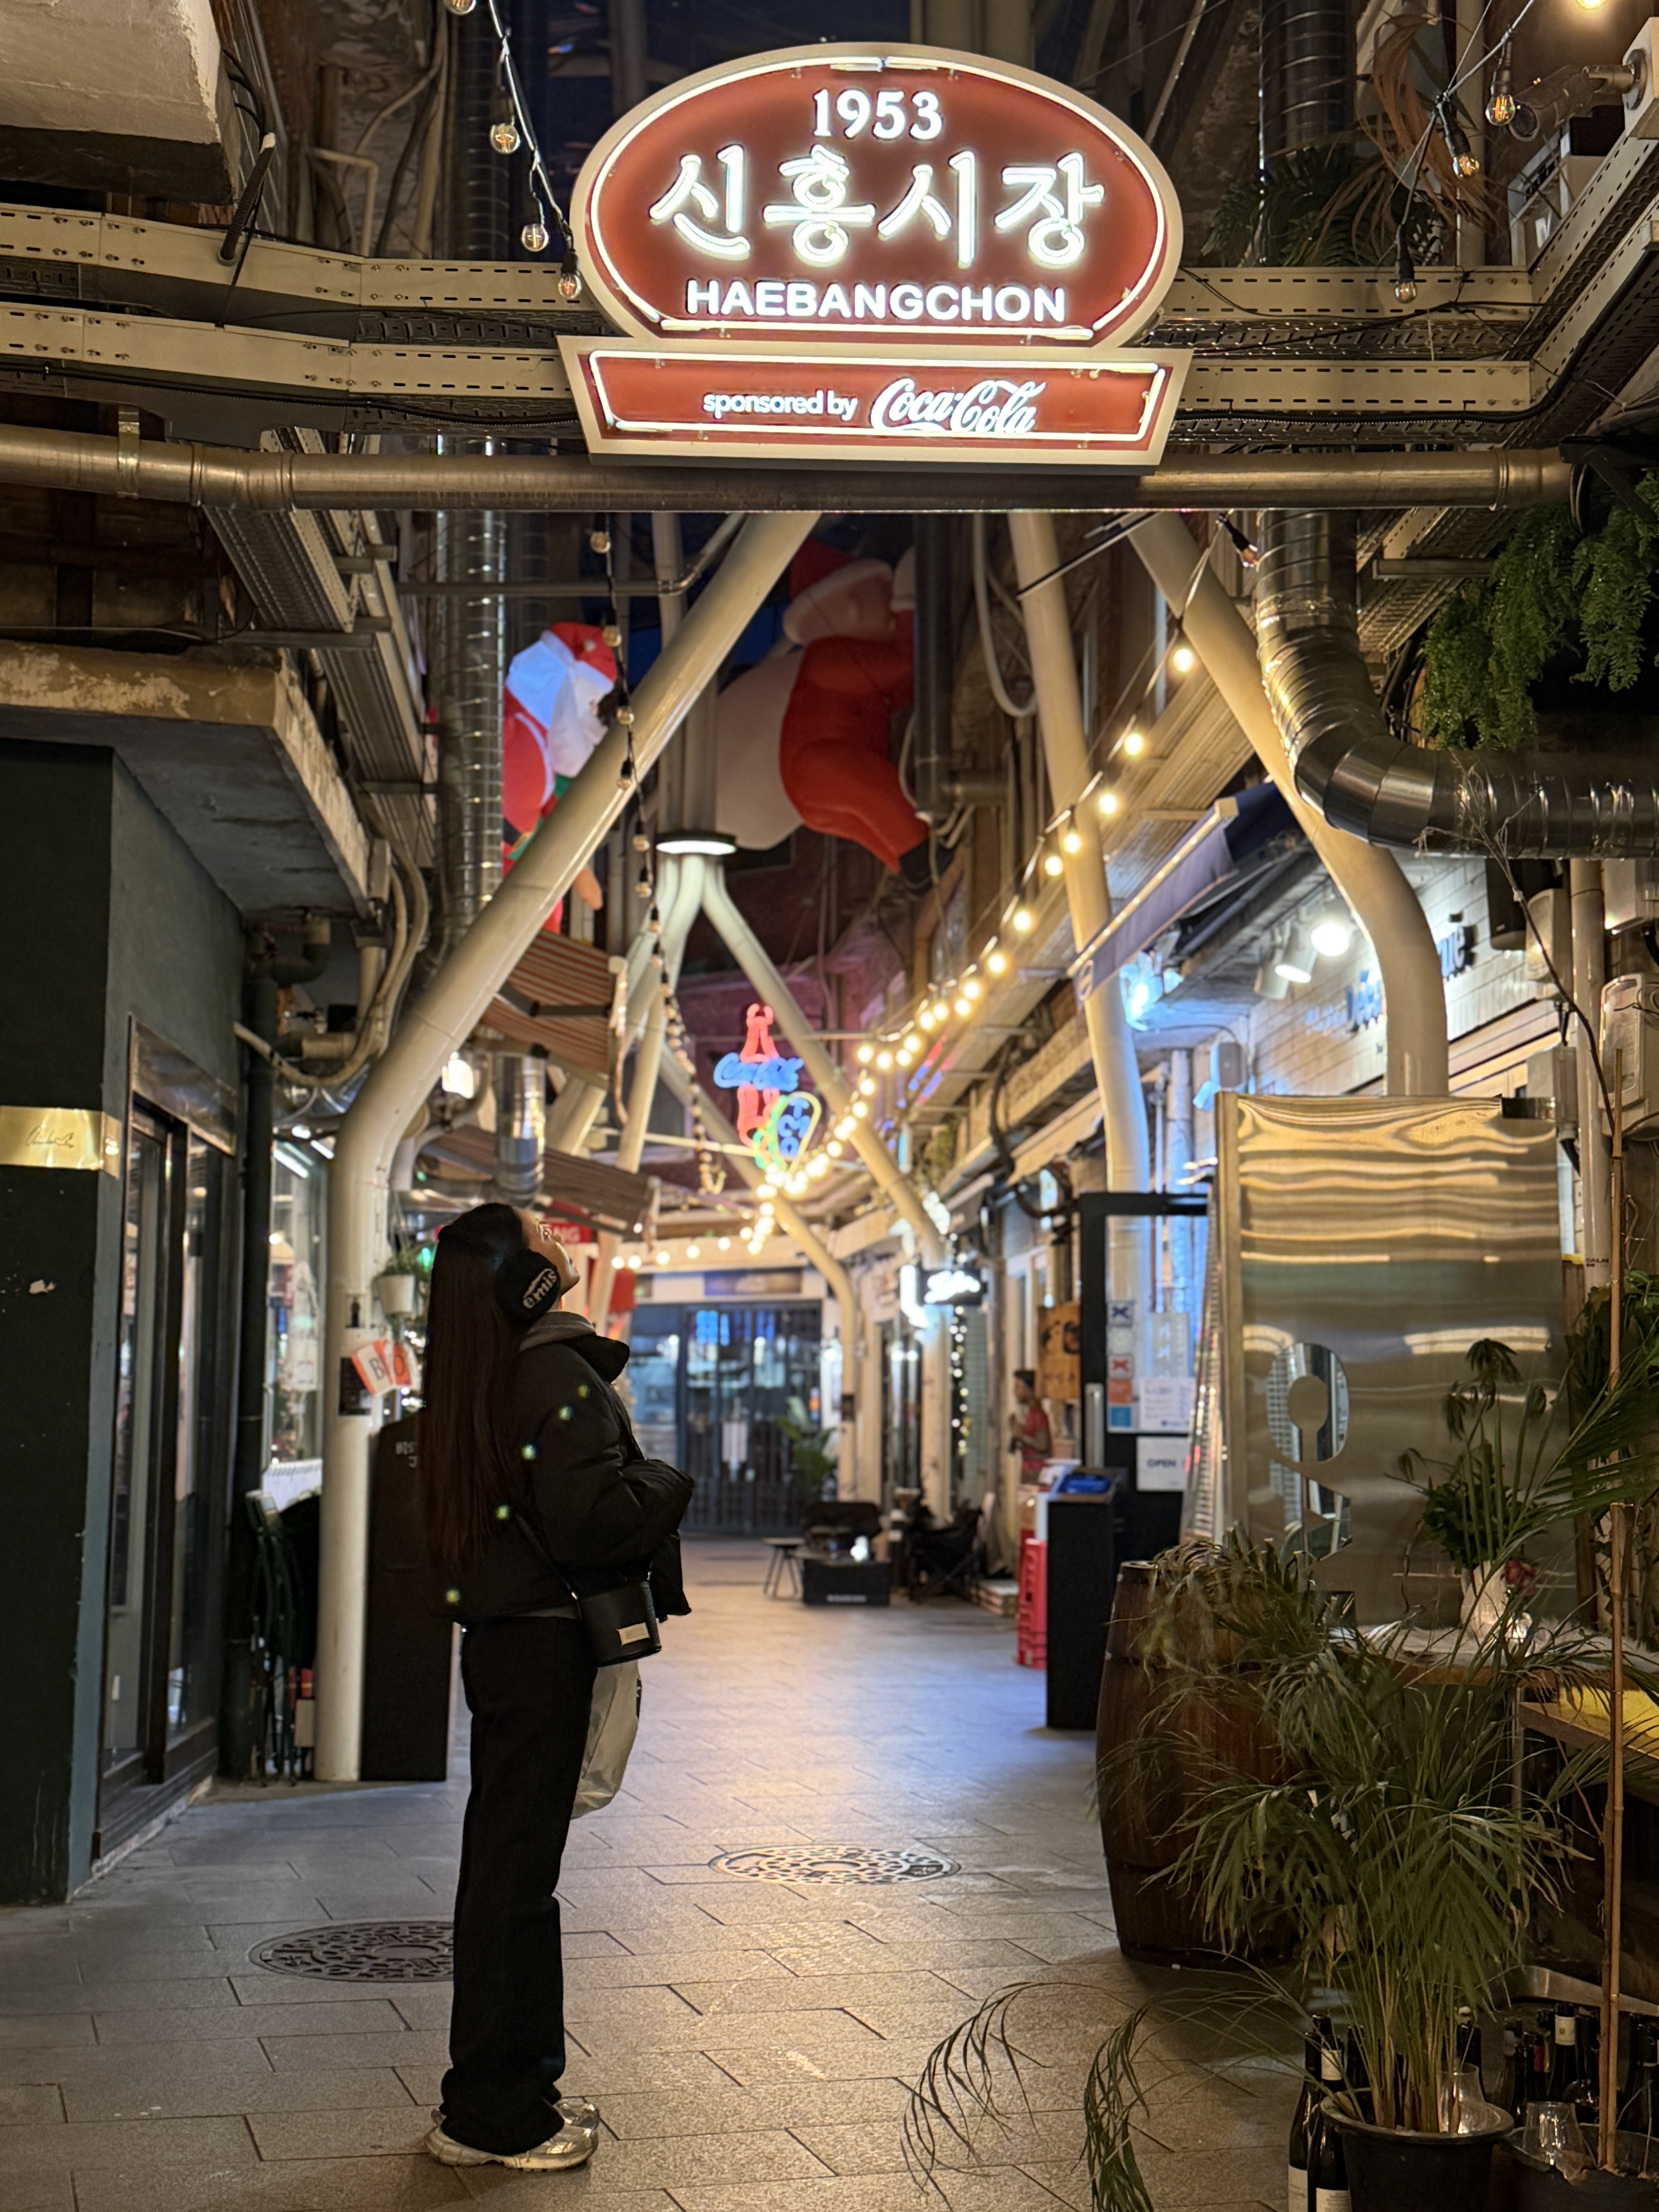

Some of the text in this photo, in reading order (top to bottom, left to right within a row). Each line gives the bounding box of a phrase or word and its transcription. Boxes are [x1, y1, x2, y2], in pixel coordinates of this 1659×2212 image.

[813, 89, 944, 141] 1953
[649, 143, 1105, 269] 신흥시장
[685, 279, 1066, 322] HAEBANGCHON
[702, 389, 823, 419] sponsored
[826, 390, 858, 421] by
[523, 1269, 557, 1309] emis
[1146, 1458, 1177, 1468] OPEN
